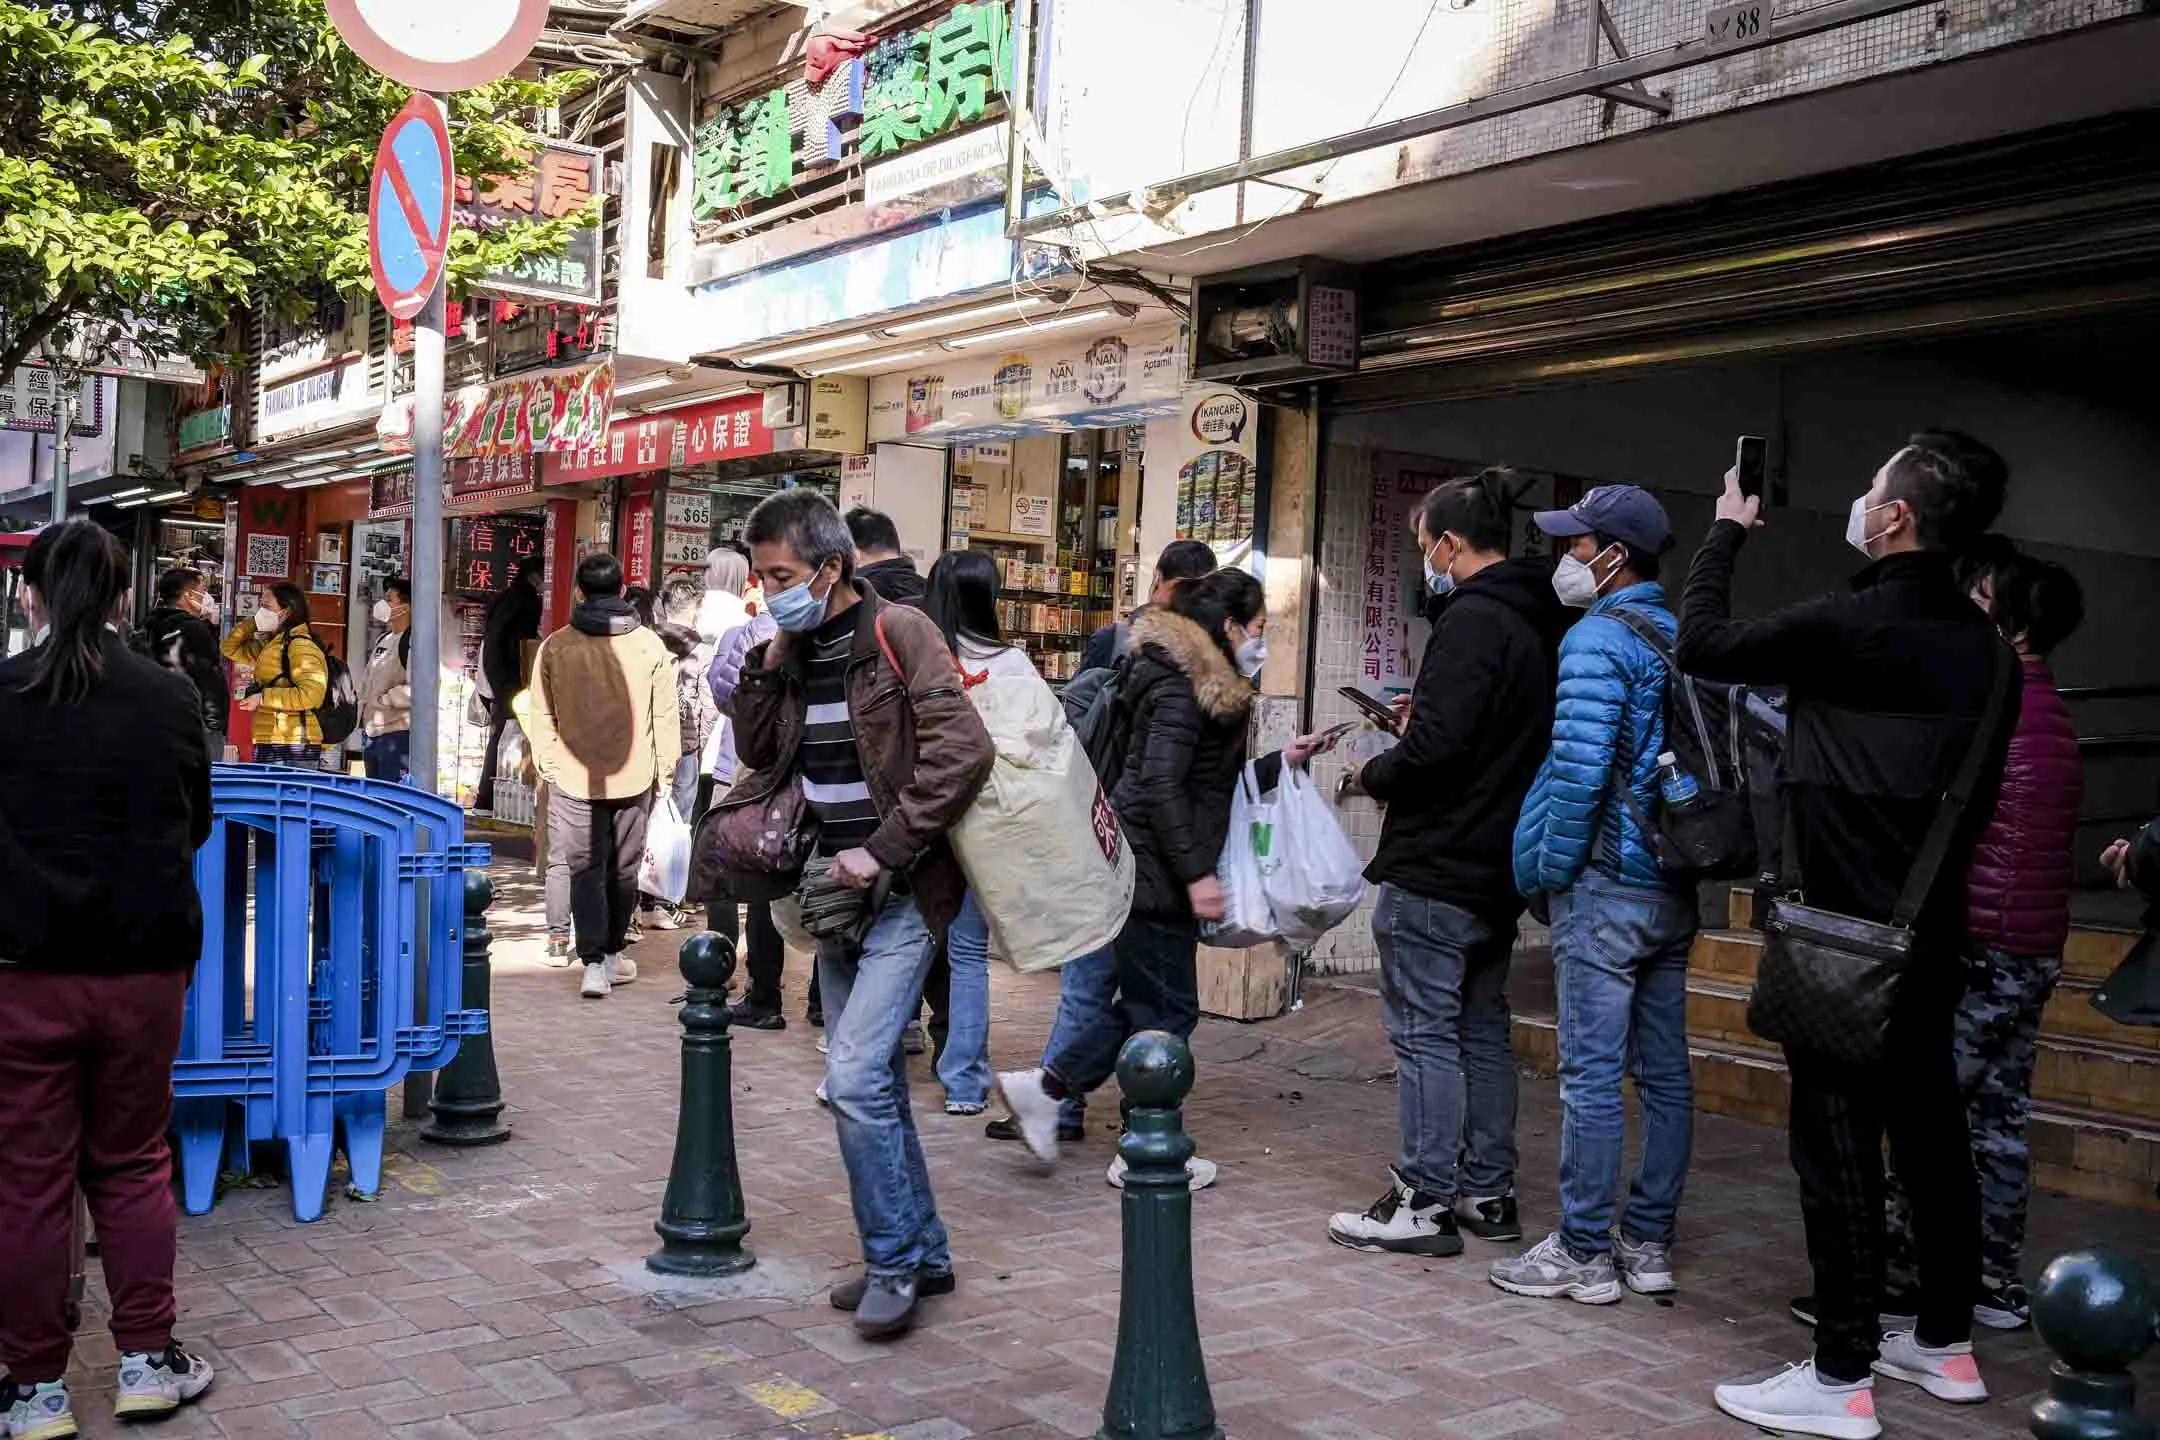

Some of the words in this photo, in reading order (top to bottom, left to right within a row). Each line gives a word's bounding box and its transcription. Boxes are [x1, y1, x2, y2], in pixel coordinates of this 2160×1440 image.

[1737, 7, 1760, 39] 88
[1050, 365, 1074, 378] NAN
[1144, 357, 1171, 370] Aptamil
[952, 388, 968, 399] Friso
[1201, 403, 1240, 417] IKANCARE
[672, 411, 752, 466] 信心保證
[684, 507, 709, 523] $65
[470, 523, 535, 556] 信心
[631, 512, 645, 586] 政府註
